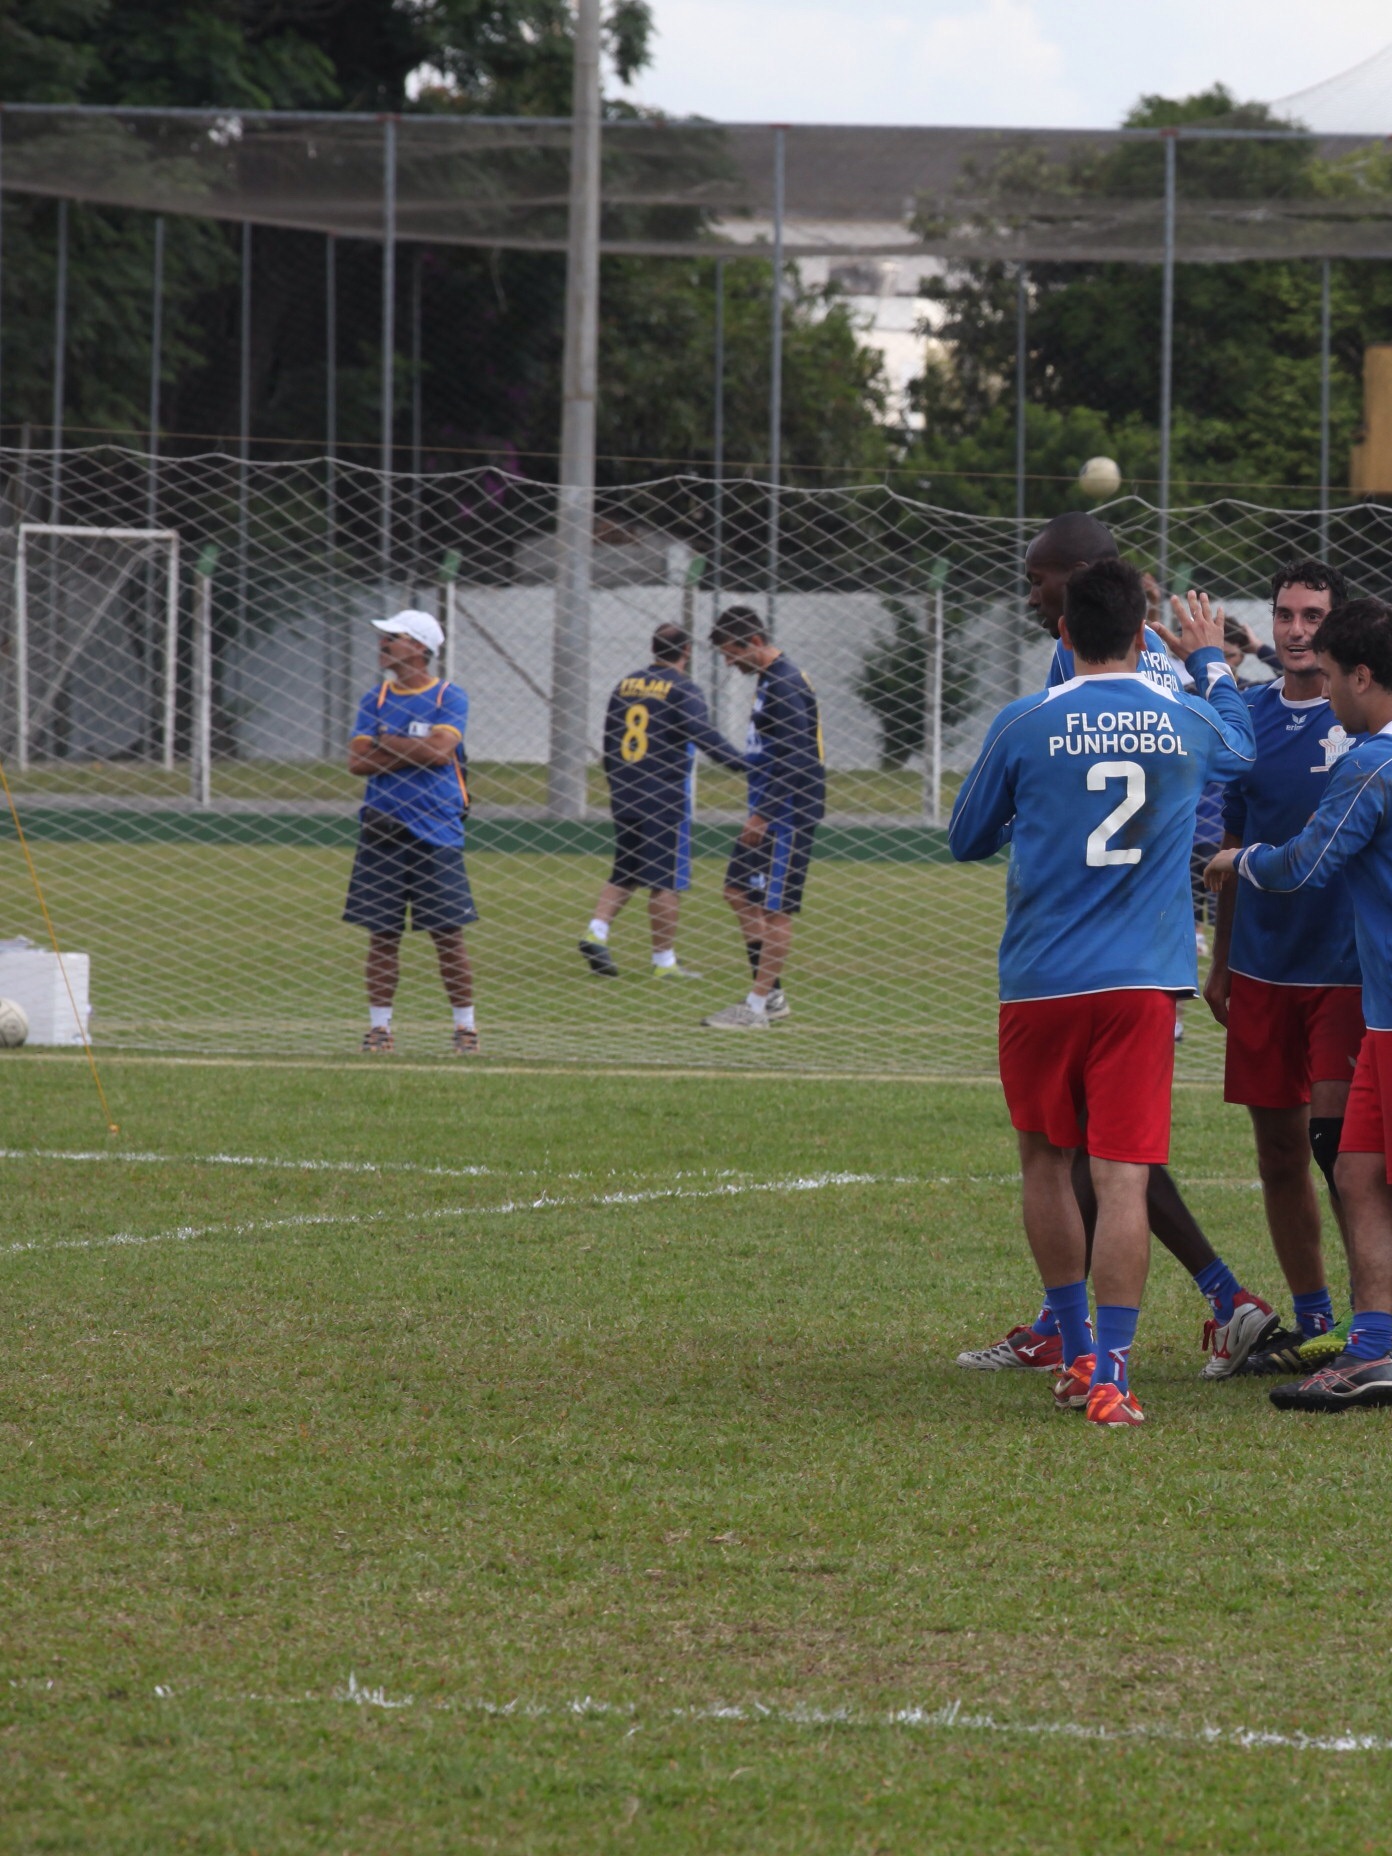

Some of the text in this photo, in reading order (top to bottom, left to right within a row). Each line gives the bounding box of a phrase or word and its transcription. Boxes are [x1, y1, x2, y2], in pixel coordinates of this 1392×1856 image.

[621, 704, 649, 763] 8
[1066, 711, 1174, 733] FLORIPA
[1050, 734, 1188, 757] PUNHOBOL
[1086, 761, 1146, 867] 2
